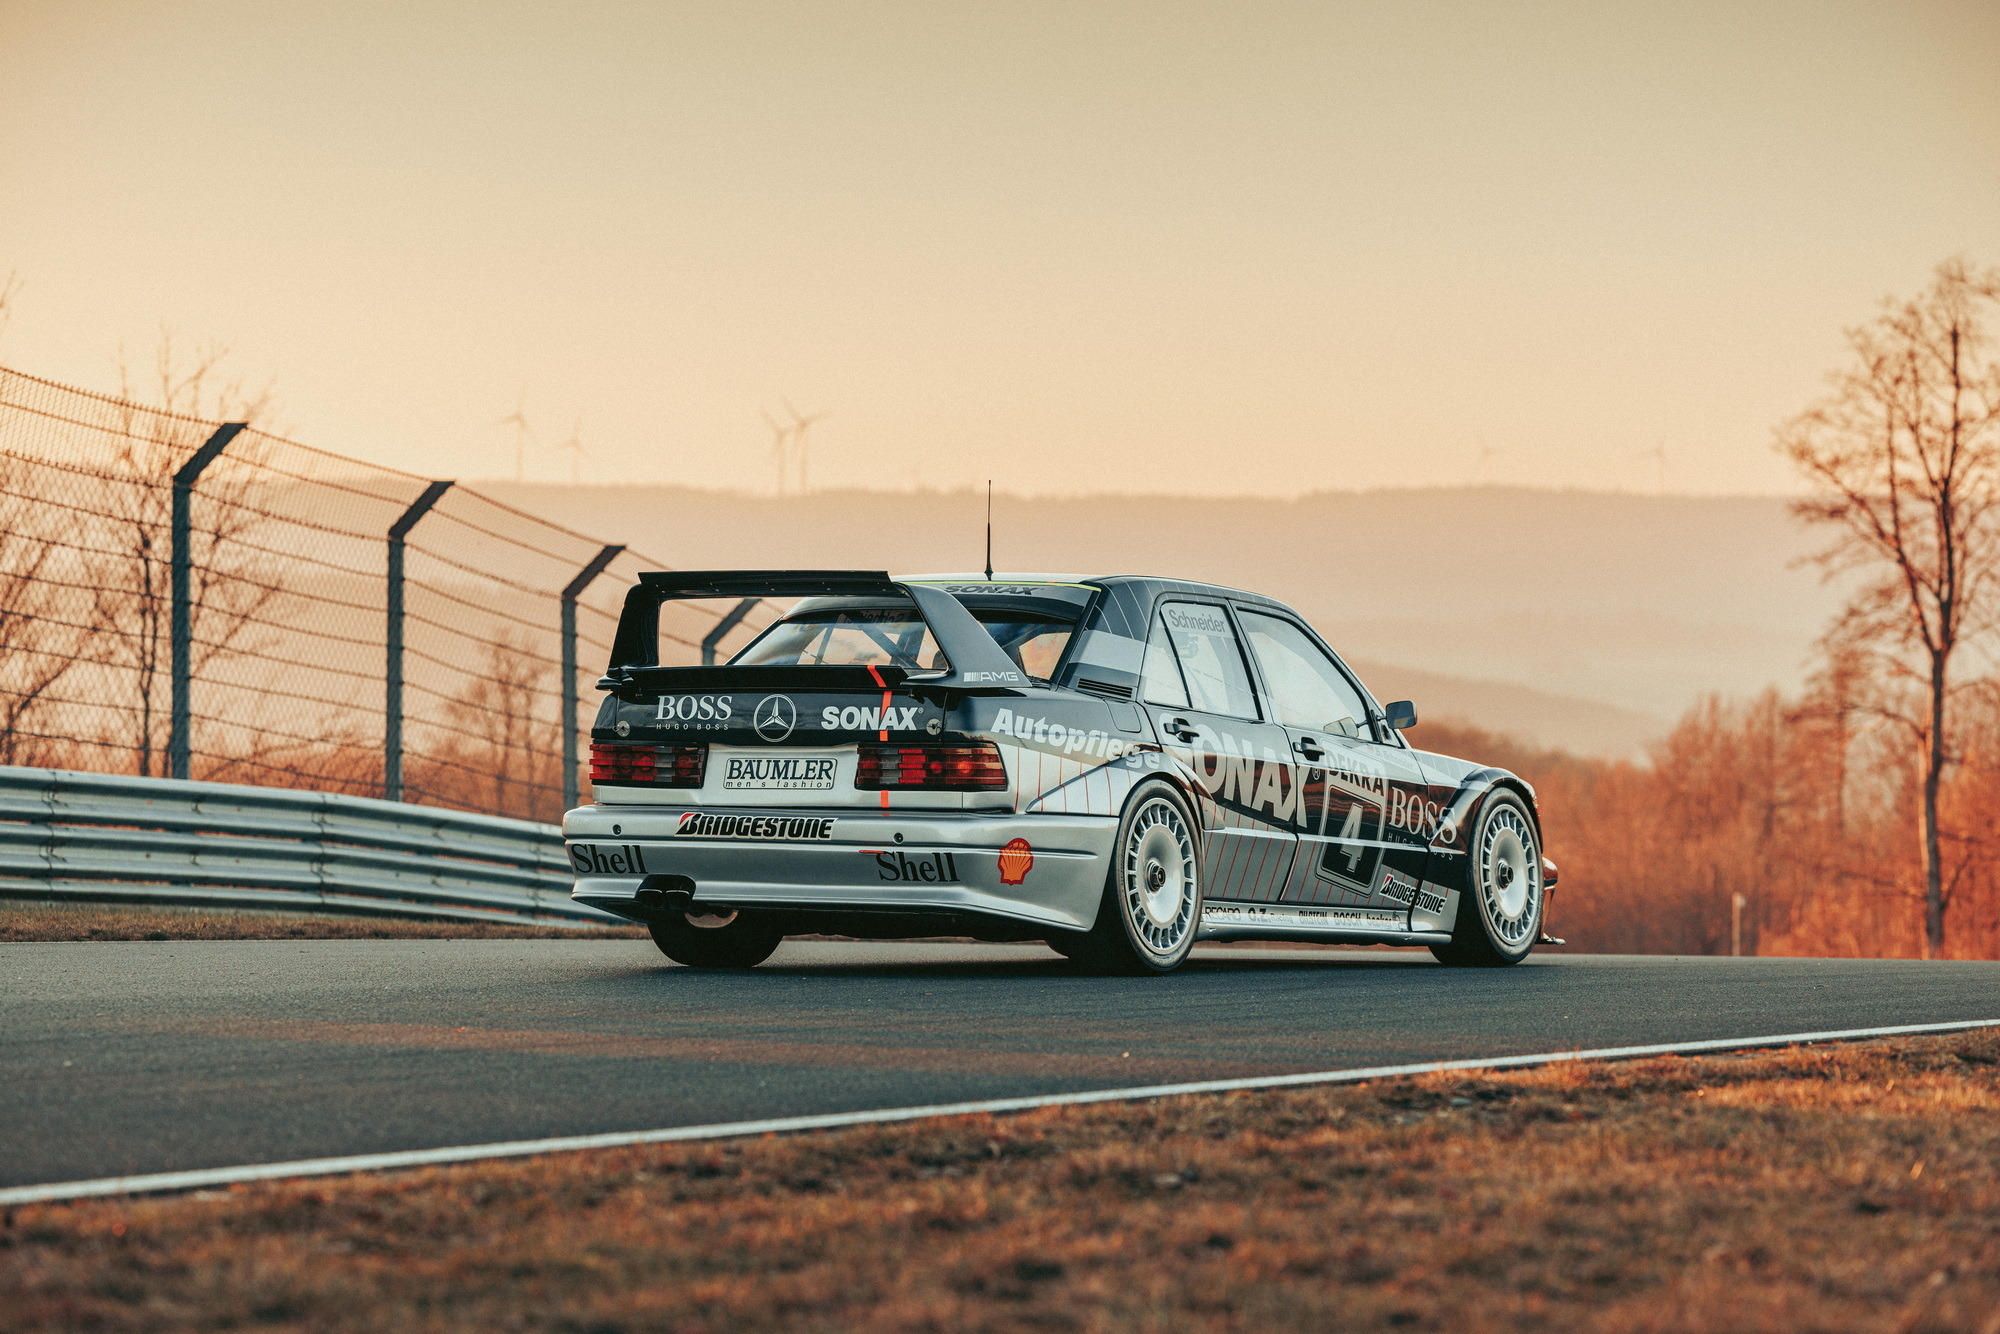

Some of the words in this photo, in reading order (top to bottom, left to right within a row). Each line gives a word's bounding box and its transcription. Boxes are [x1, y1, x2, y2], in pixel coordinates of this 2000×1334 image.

[1168, 609, 1226, 632] Schneider
[980, 672, 1019, 682] AMG
[655, 695, 733, 721] BOSS
[656, 723, 689, 731] HUGO
[696, 723, 729, 731] BOSS
[990, 707, 1160, 770] Autopflege
[726, 759, 834, 780] BÄUMLER
[1325, 751, 1385, 797] DEKRA
[725, 780, 767, 788] men's
[776, 780, 833, 789] fashion
[675, 813, 835, 839] BRIDGESTONE
[1389, 786, 1457, 844] BOSS
[1339, 803, 1364, 873] 4
[571, 843, 649, 875] Shell
[876, 851, 961, 882] Shell
[1380, 875, 1446, 914] BRIDGESTONE
[1204, 906, 1241, 921] RECARO
[1298, 910, 1329, 925] BILSTEIN
[1333, 911, 1363, 926] BOSCH
